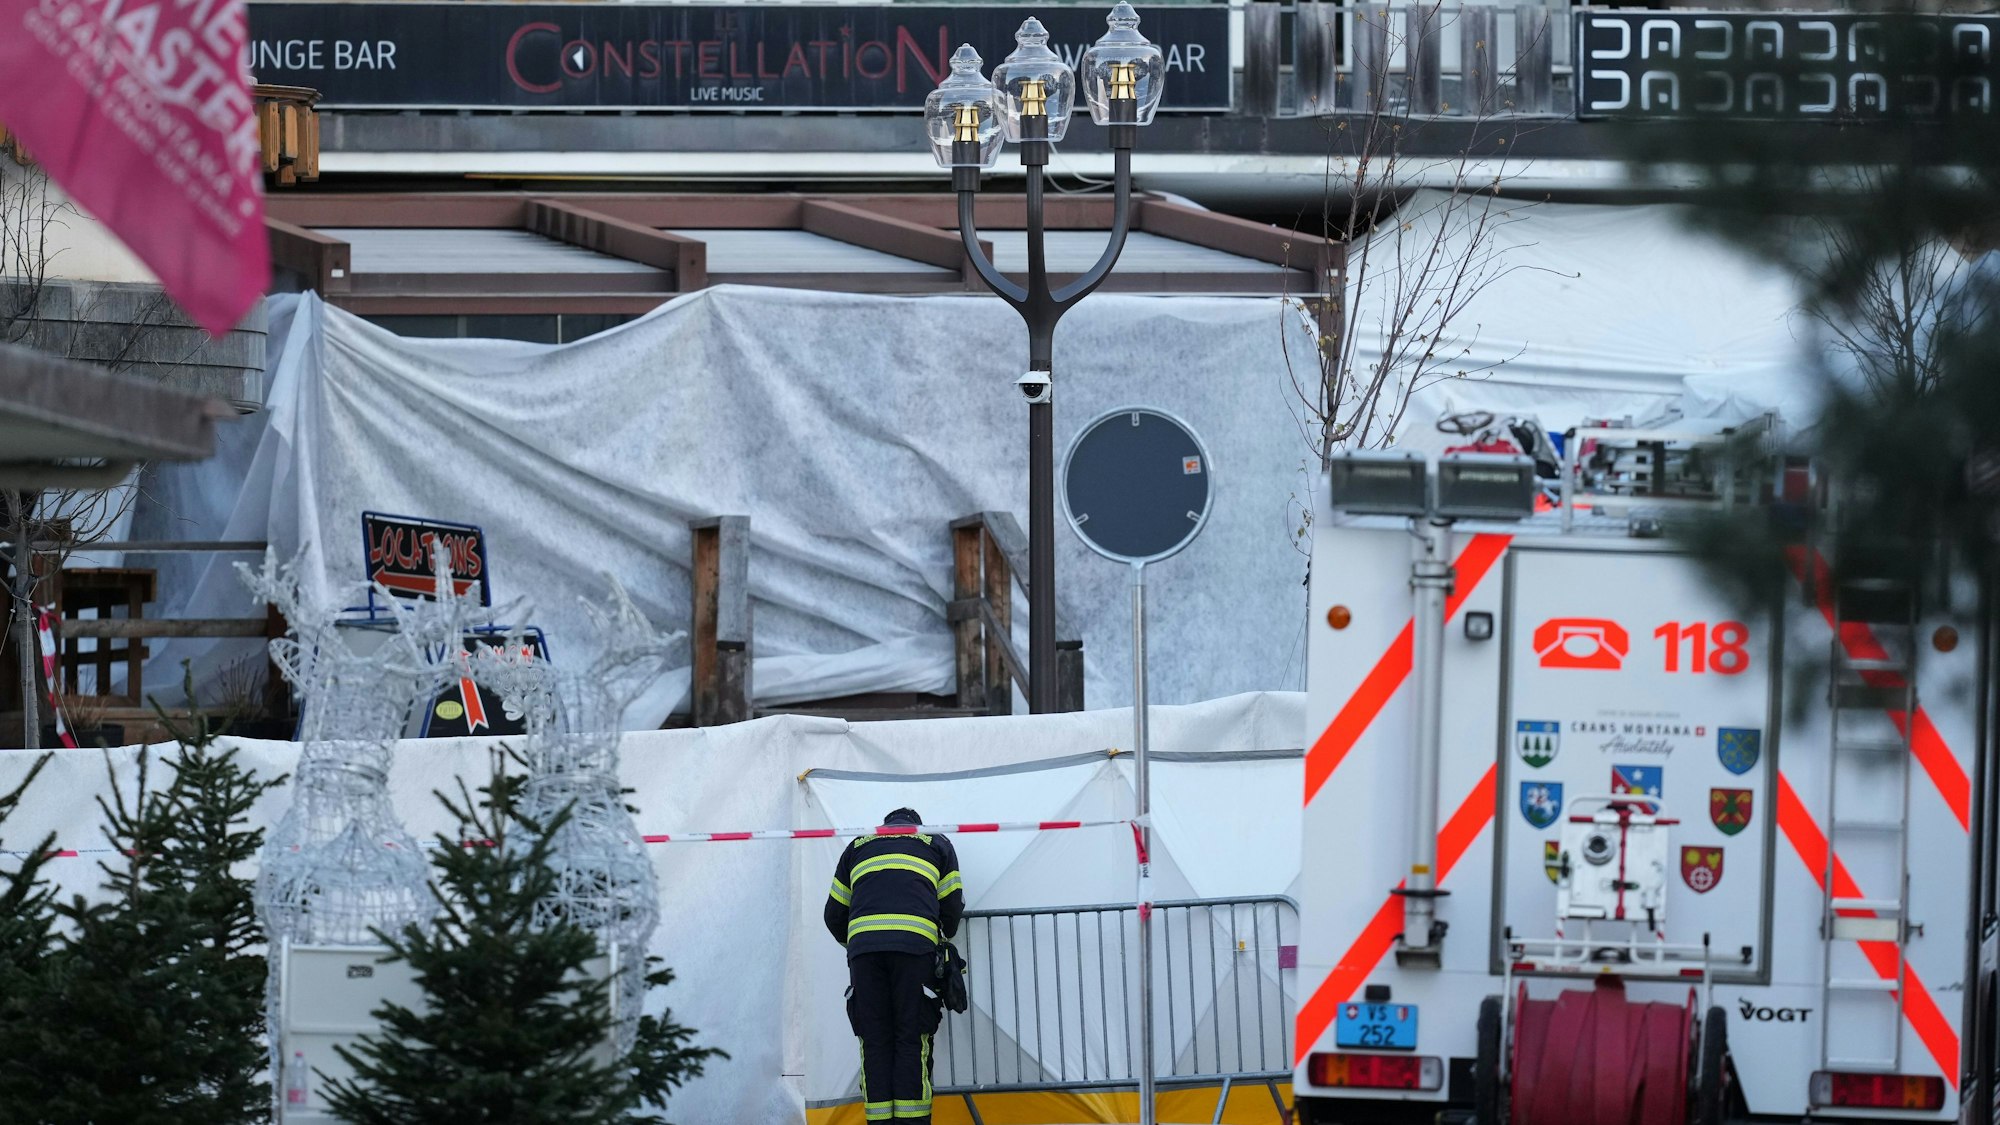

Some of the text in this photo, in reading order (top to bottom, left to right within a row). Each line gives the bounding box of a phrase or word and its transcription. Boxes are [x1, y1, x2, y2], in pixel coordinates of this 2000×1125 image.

[335, 40, 396, 70] BAR
[1156, 44, 1205, 72] AR
[690, 87, 764, 101] LIVE MUSIC
[368, 522, 482, 577] LOCATONS
[1653, 620, 1750, 675] 118
[1570, 721, 1691, 737] CRANS MONTANA
[1368, 1005, 1388, 1021] VS
[1739, 1004, 1813, 1023] VOGT
[1359, 1024, 1396, 1046] 252
